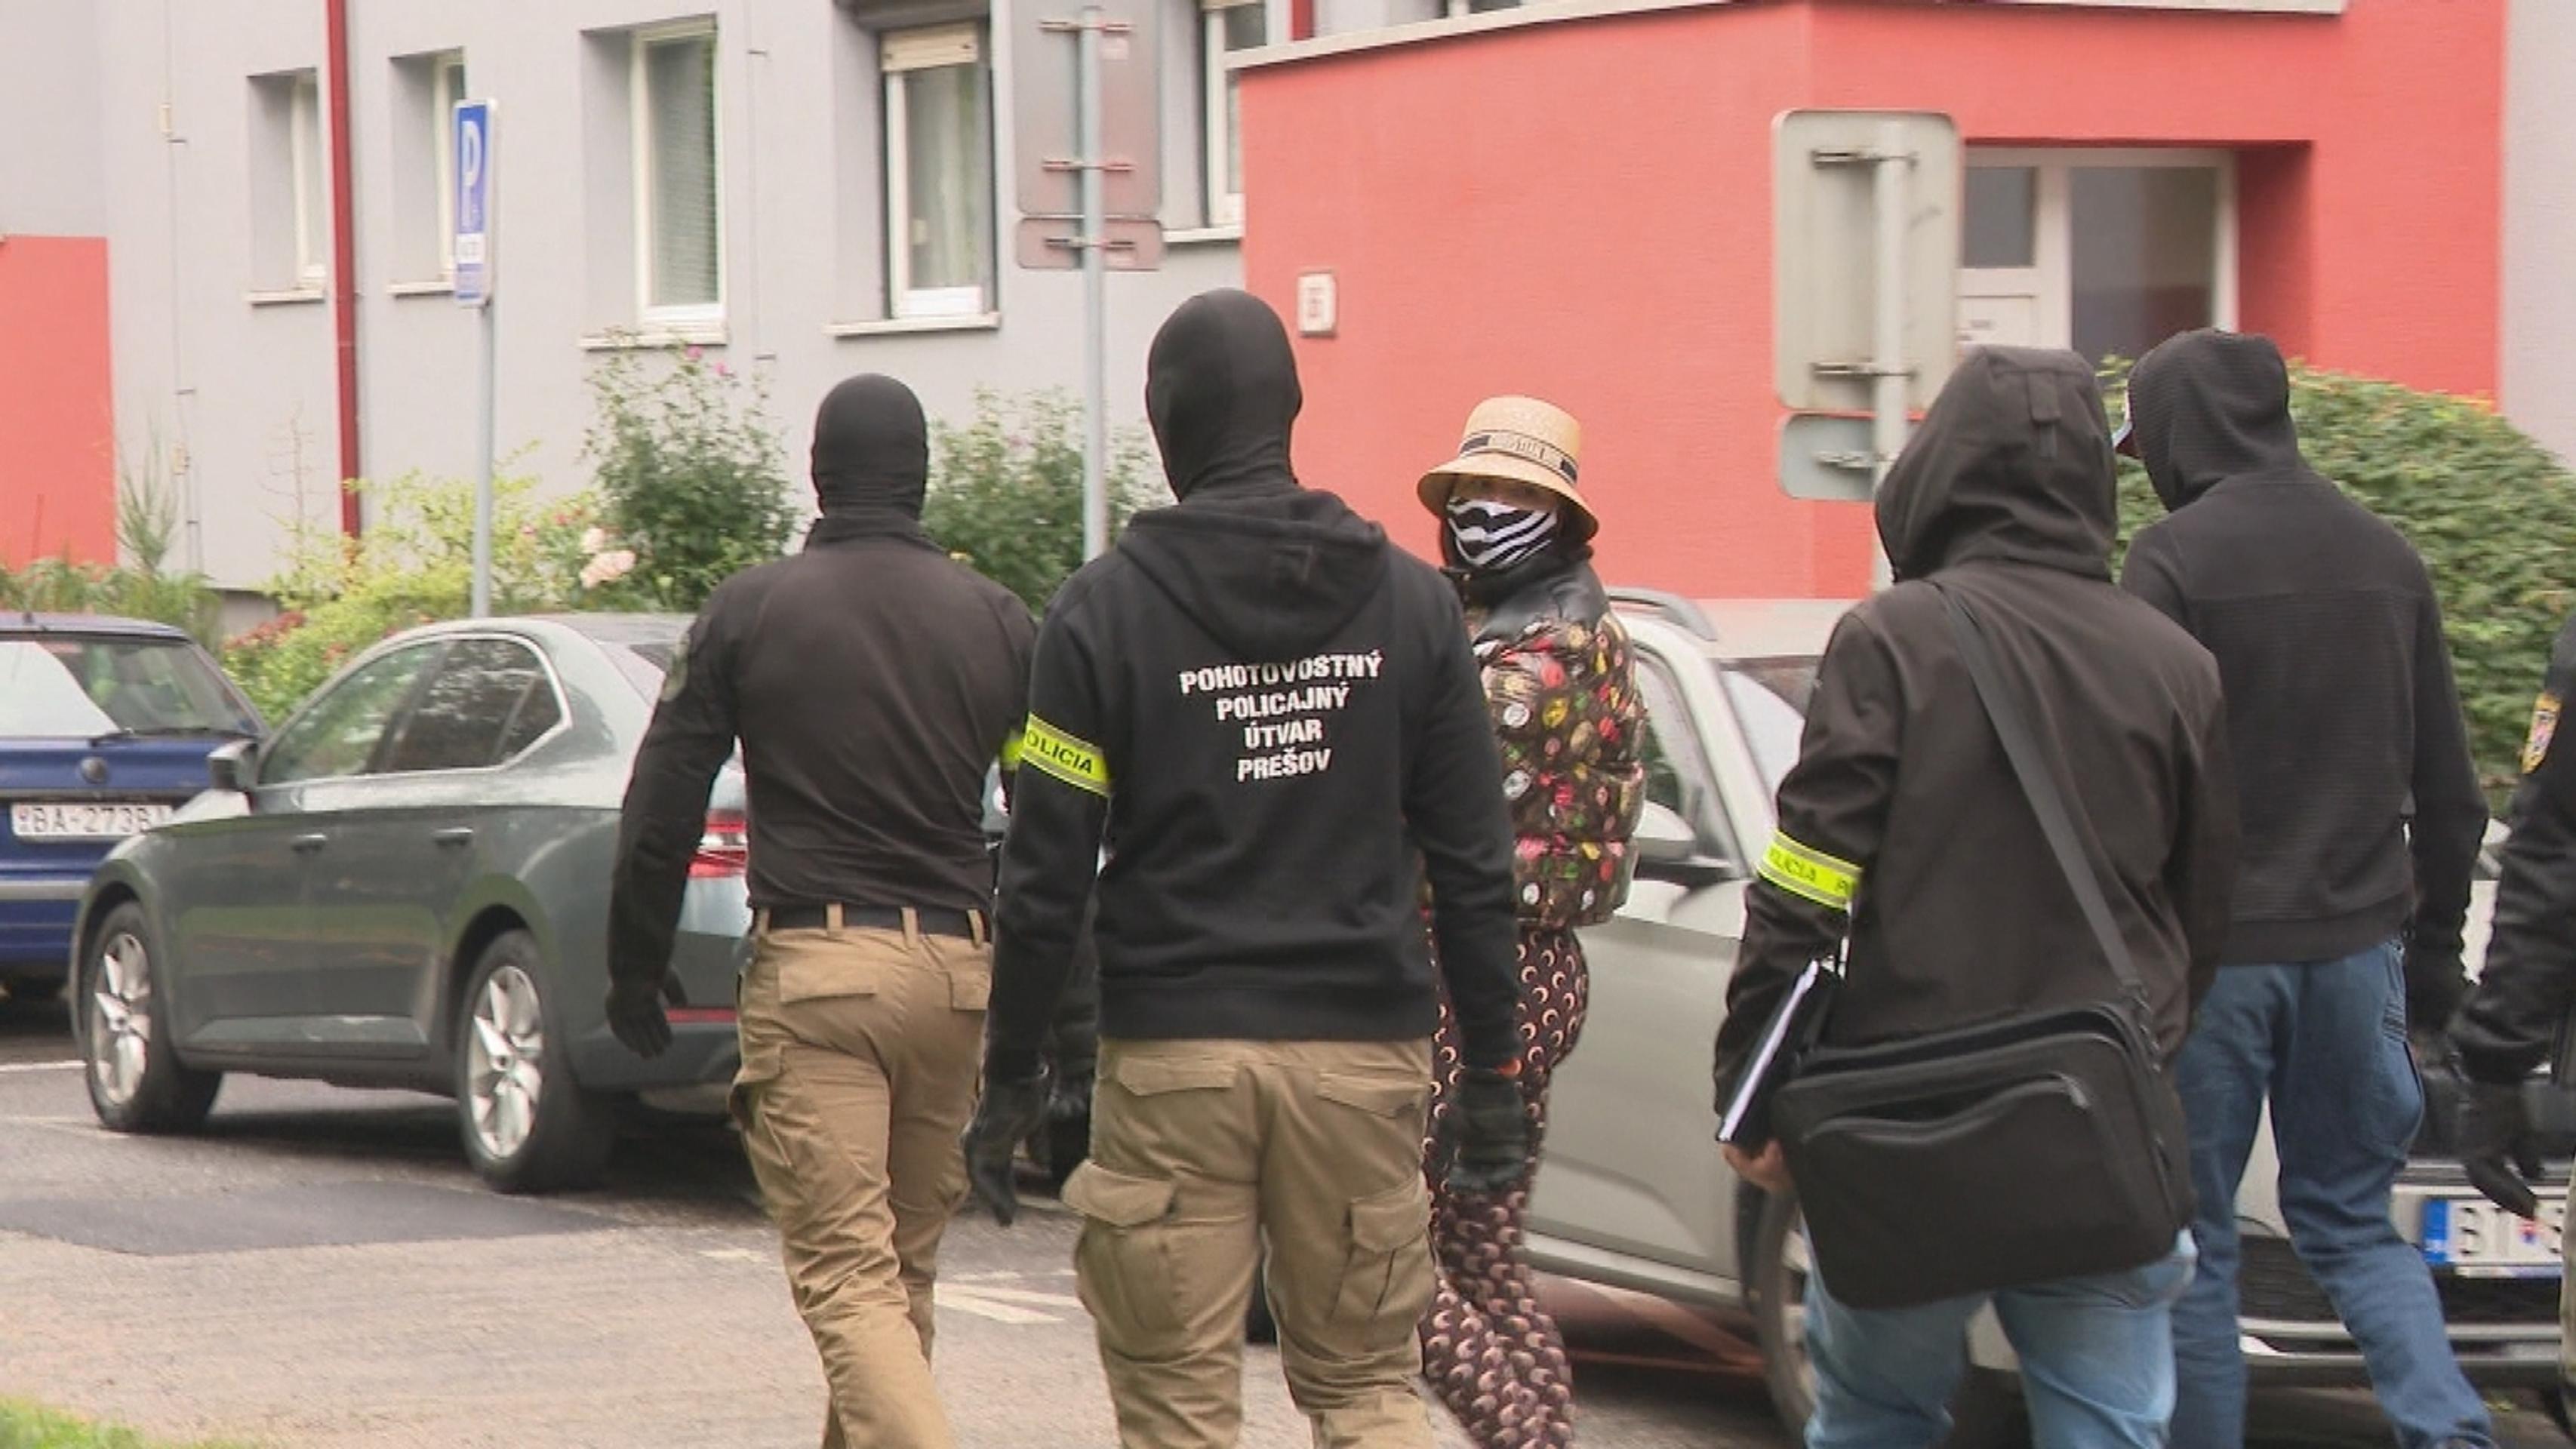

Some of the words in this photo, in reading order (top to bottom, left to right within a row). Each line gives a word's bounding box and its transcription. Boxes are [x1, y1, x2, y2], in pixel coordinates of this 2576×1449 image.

[461, 120, 482, 227] P
[1180, 649, 1383, 694] POHOTOVOSTNÝ
[1216, 681, 1350, 721] POLICAJNÝ
[1245, 718, 1322, 749] ÚTVAR
[1237, 748, 1331, 782] PREŠOV
